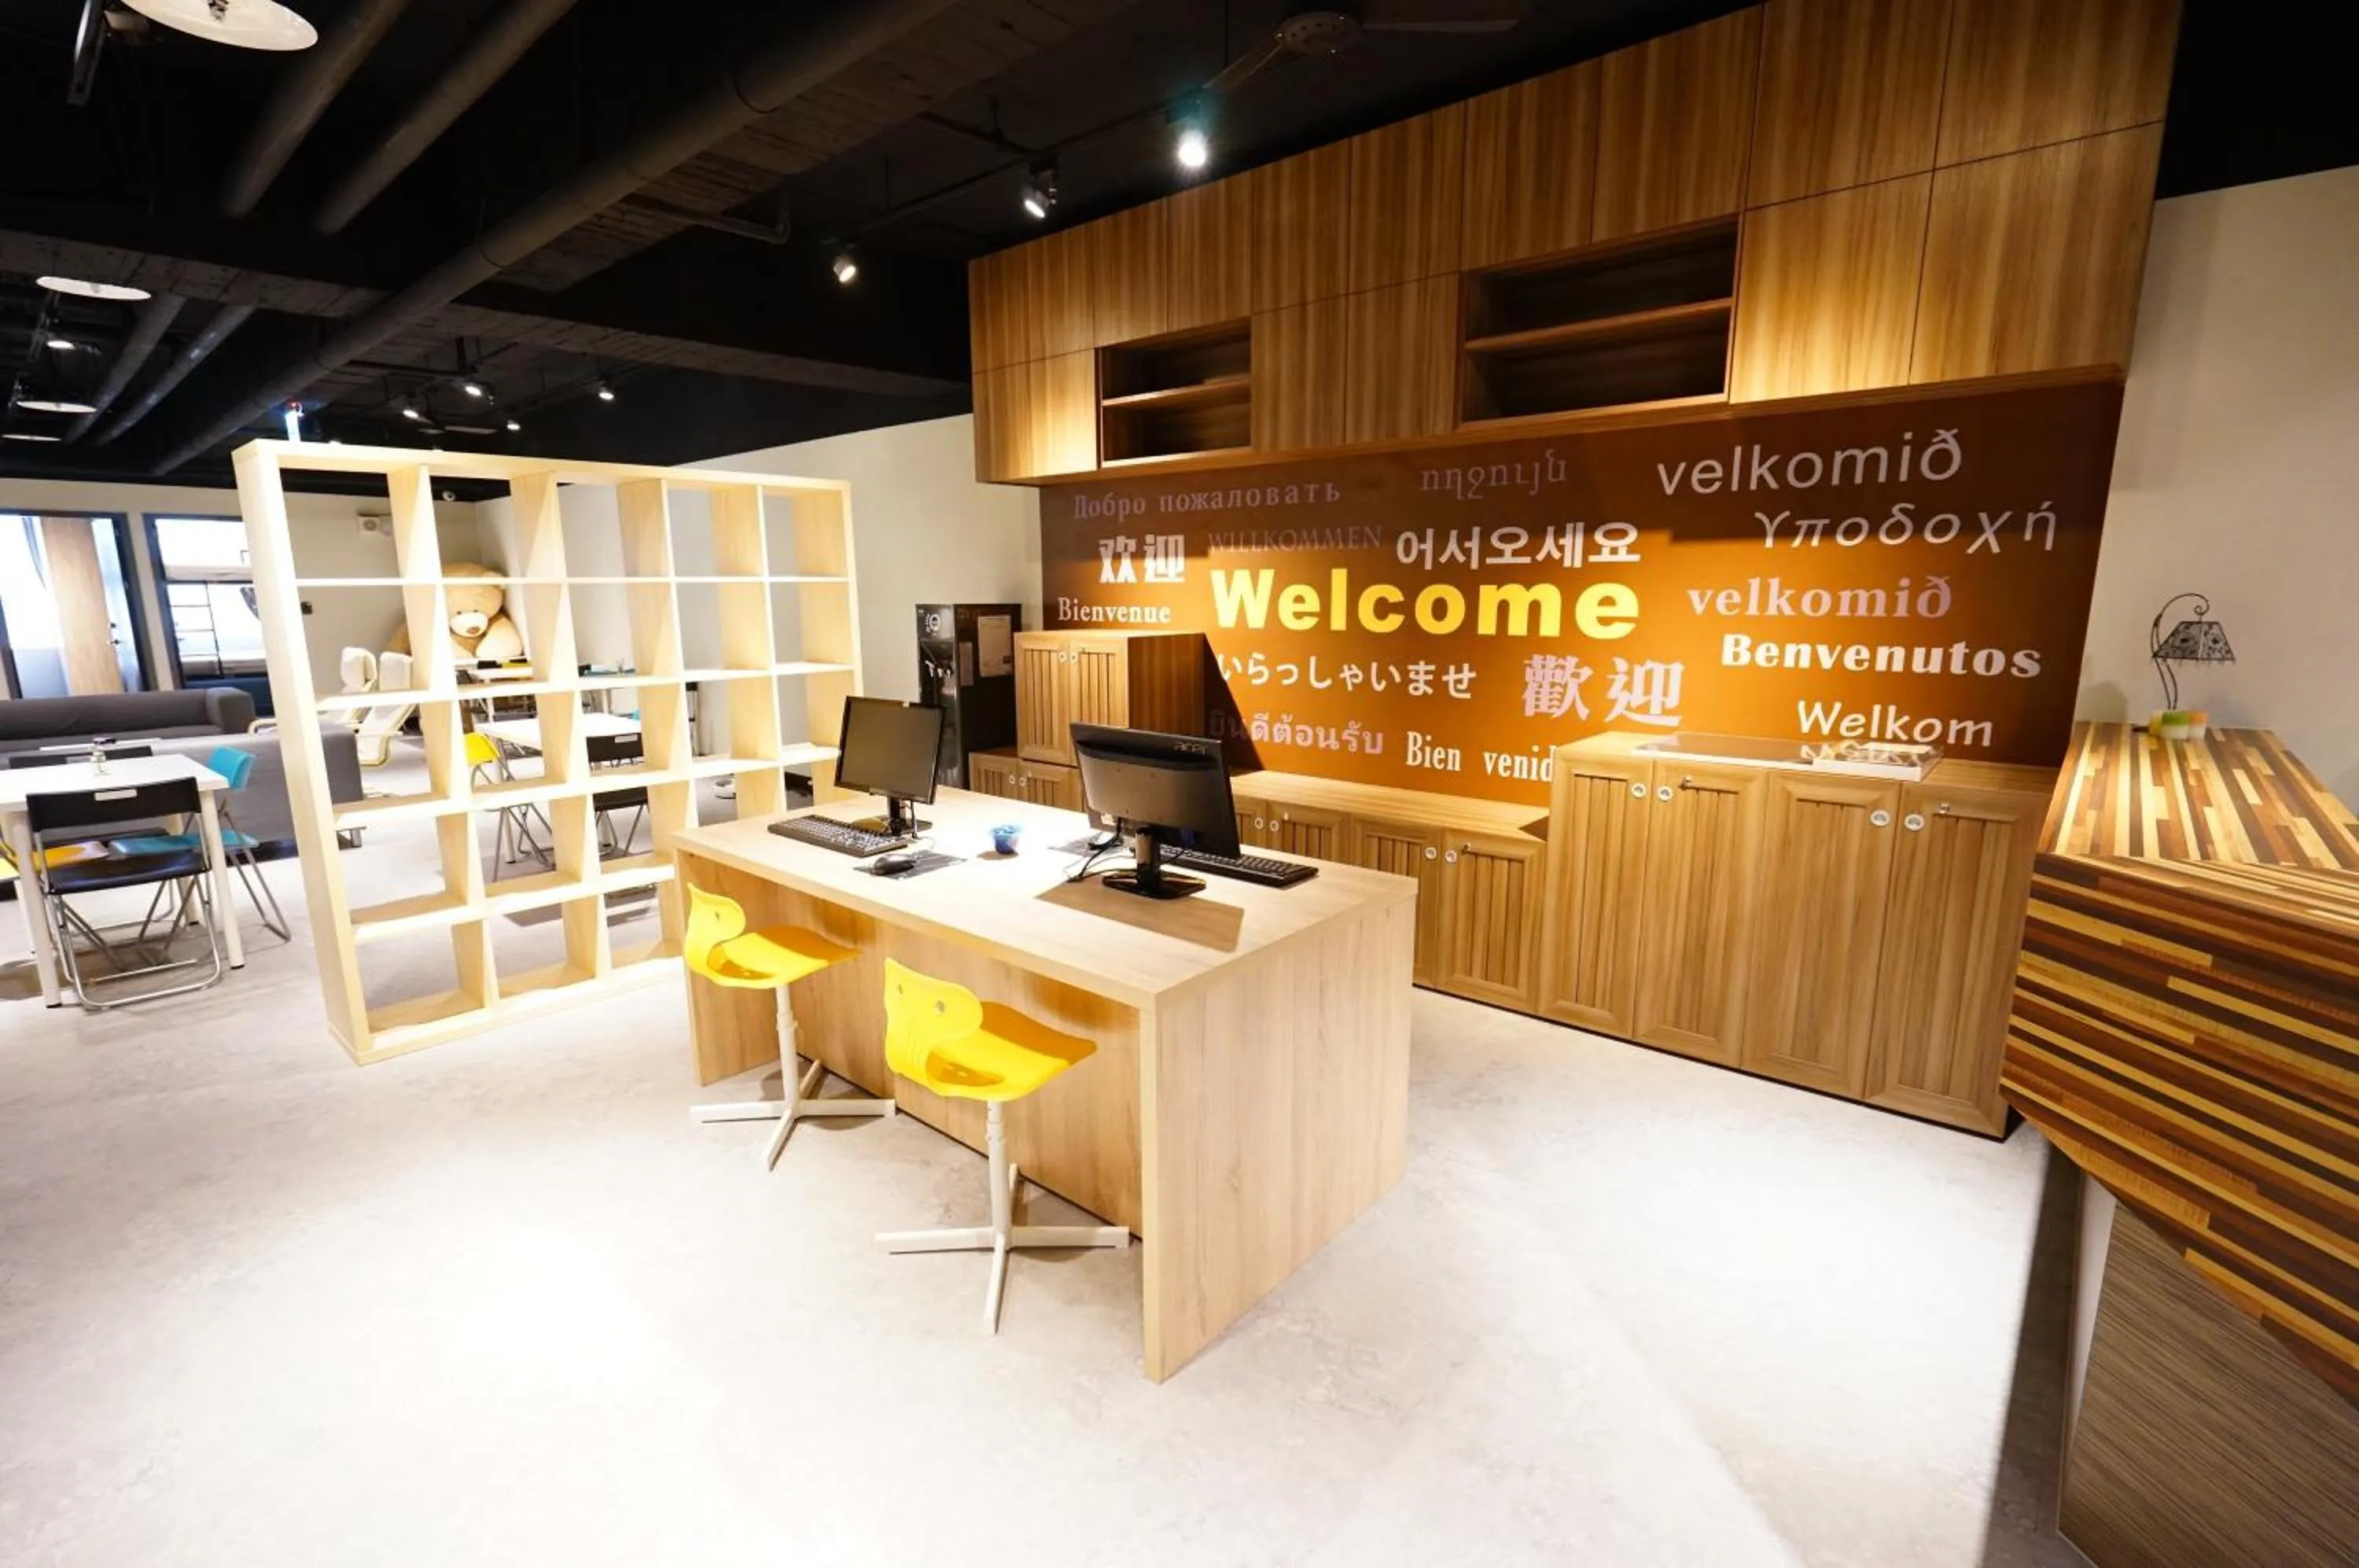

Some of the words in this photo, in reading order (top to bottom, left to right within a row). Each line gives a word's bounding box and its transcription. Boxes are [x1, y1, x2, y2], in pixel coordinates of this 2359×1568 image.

[1656, 428, 1963, 496] velkomið
[1073, 491, 1146, 522] Добро
[1159, 482, 1341, 513] пожаловать
[1098, 533, 1186, 584] 欢迎
[1207, 525, 1382, 554] WILLKOMMEN
[1396, 521, 1642, 571] 어서오세요
[1057, 596, 1172, 623] Bienvenue
[1209, 567, 1640, 640] Welcome
[1686, 575, 1952, 619] velkomið
[1216, 651, 1478, 699] いらっしゃいませ
[1720, 633, 2042, 678] Benvenutos
[1522, 653, 1684, 727] 歡迎
[1797, 700, 1993, 747] Welkom
[1405, 731, 1461, 772] Bien
